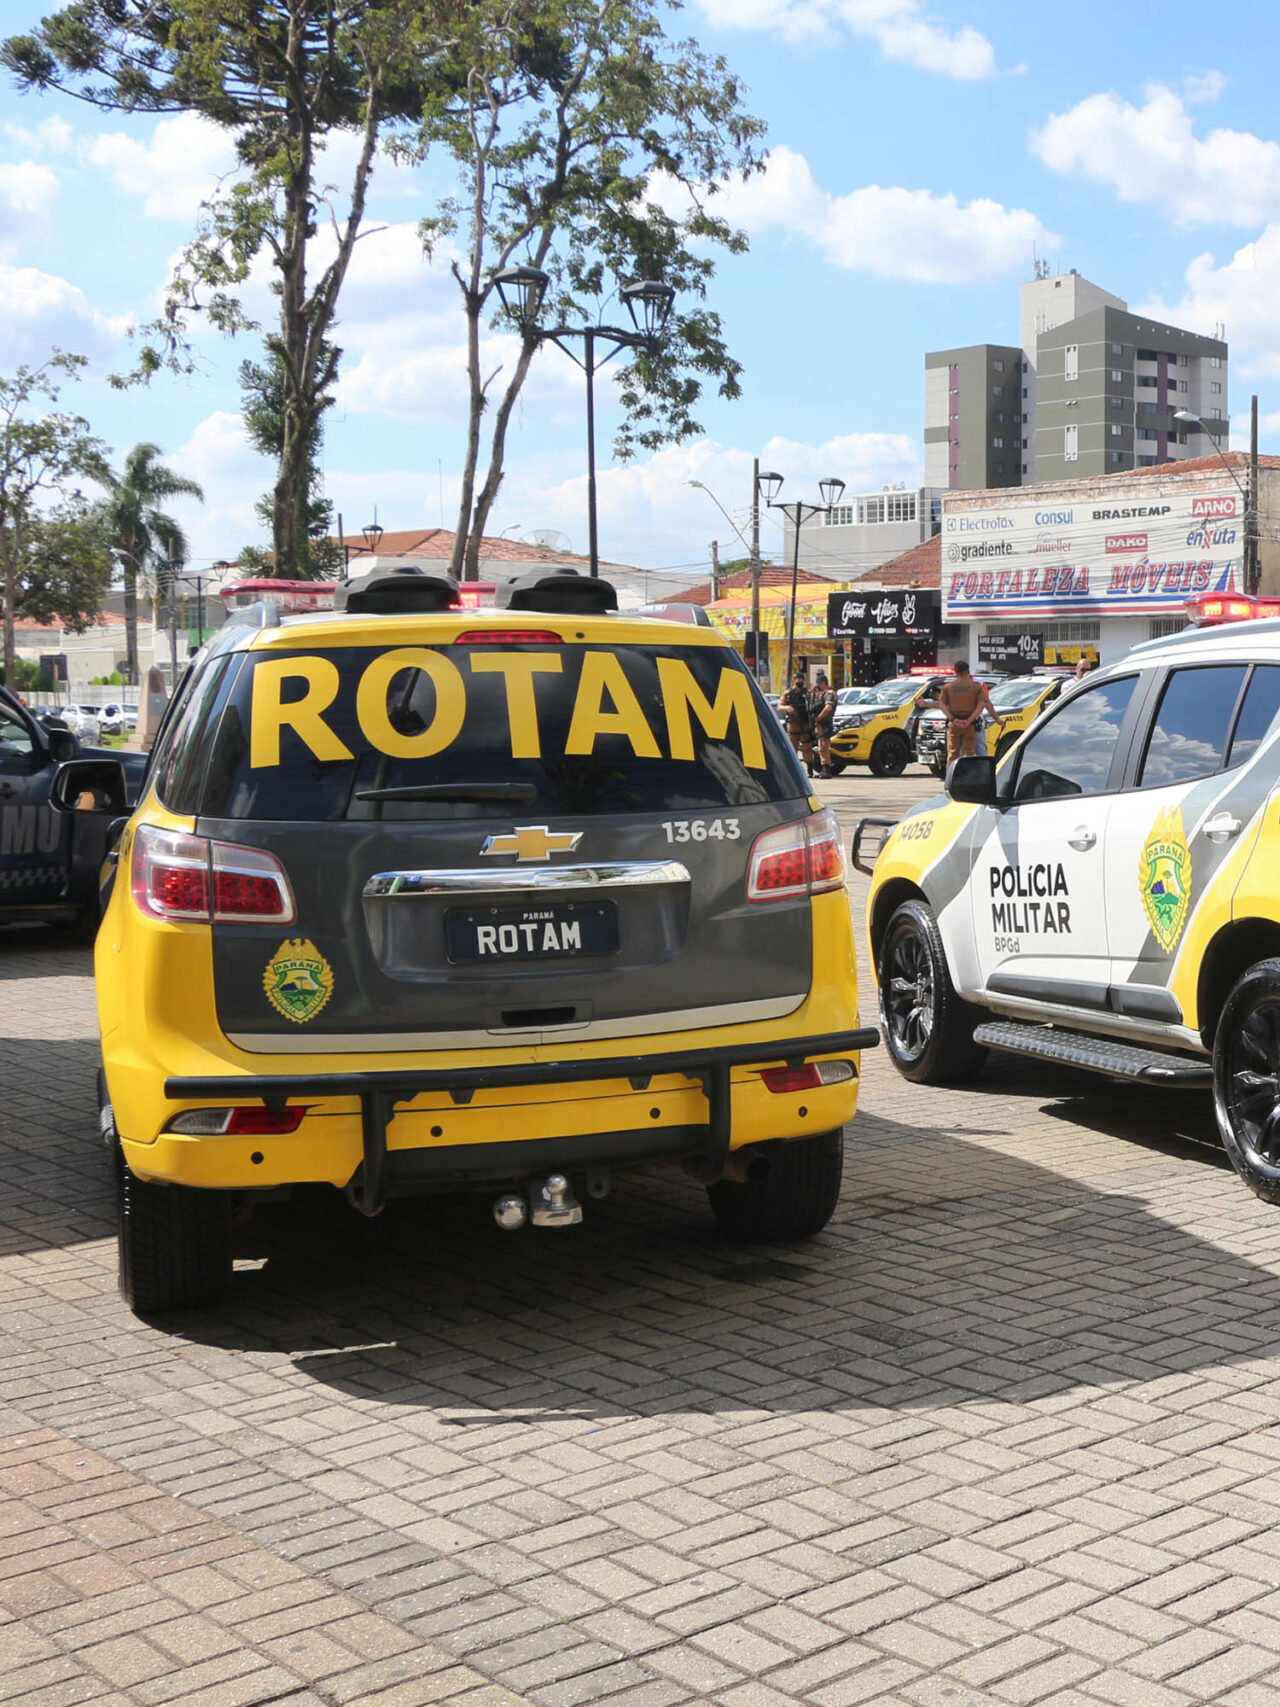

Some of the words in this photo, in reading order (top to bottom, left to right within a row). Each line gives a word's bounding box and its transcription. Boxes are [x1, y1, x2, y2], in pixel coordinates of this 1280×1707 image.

[1092, 506, 1171, 520] BRASTEMP
[1194, 500, 1235, 514] ARNO
[959, 515, 1014, 531] Electrolux
[1035, 509, 1073, 526] Consul
[961, 540, 1013, 562] gradiente
[1036, 538, 1072, 553] mueller
[1107, 537, 1147, 548] DAKO
[948, 567, 1089, 600] FORTALEZA
[1106, 555, 1213, 594] MÓVEIS
[841, 600, 867, 626] Good
[871, 598, 899, 624] Vibes
[1017, 635, 1039, 651] 10x
[250, 647, 767, 770] ROTAM
[662, 818, 741, 843] 13643
[899, 820, 935, 842] 14058
[989, 863, 1069, 898] POLÍCIA
[523, 910, 555, 921] PARANÁ
[991, 902, 1072, 934] MILITAR
[477, 921, 582, 955] ROTAM
[994, 937, 1021, 953] BPGd
